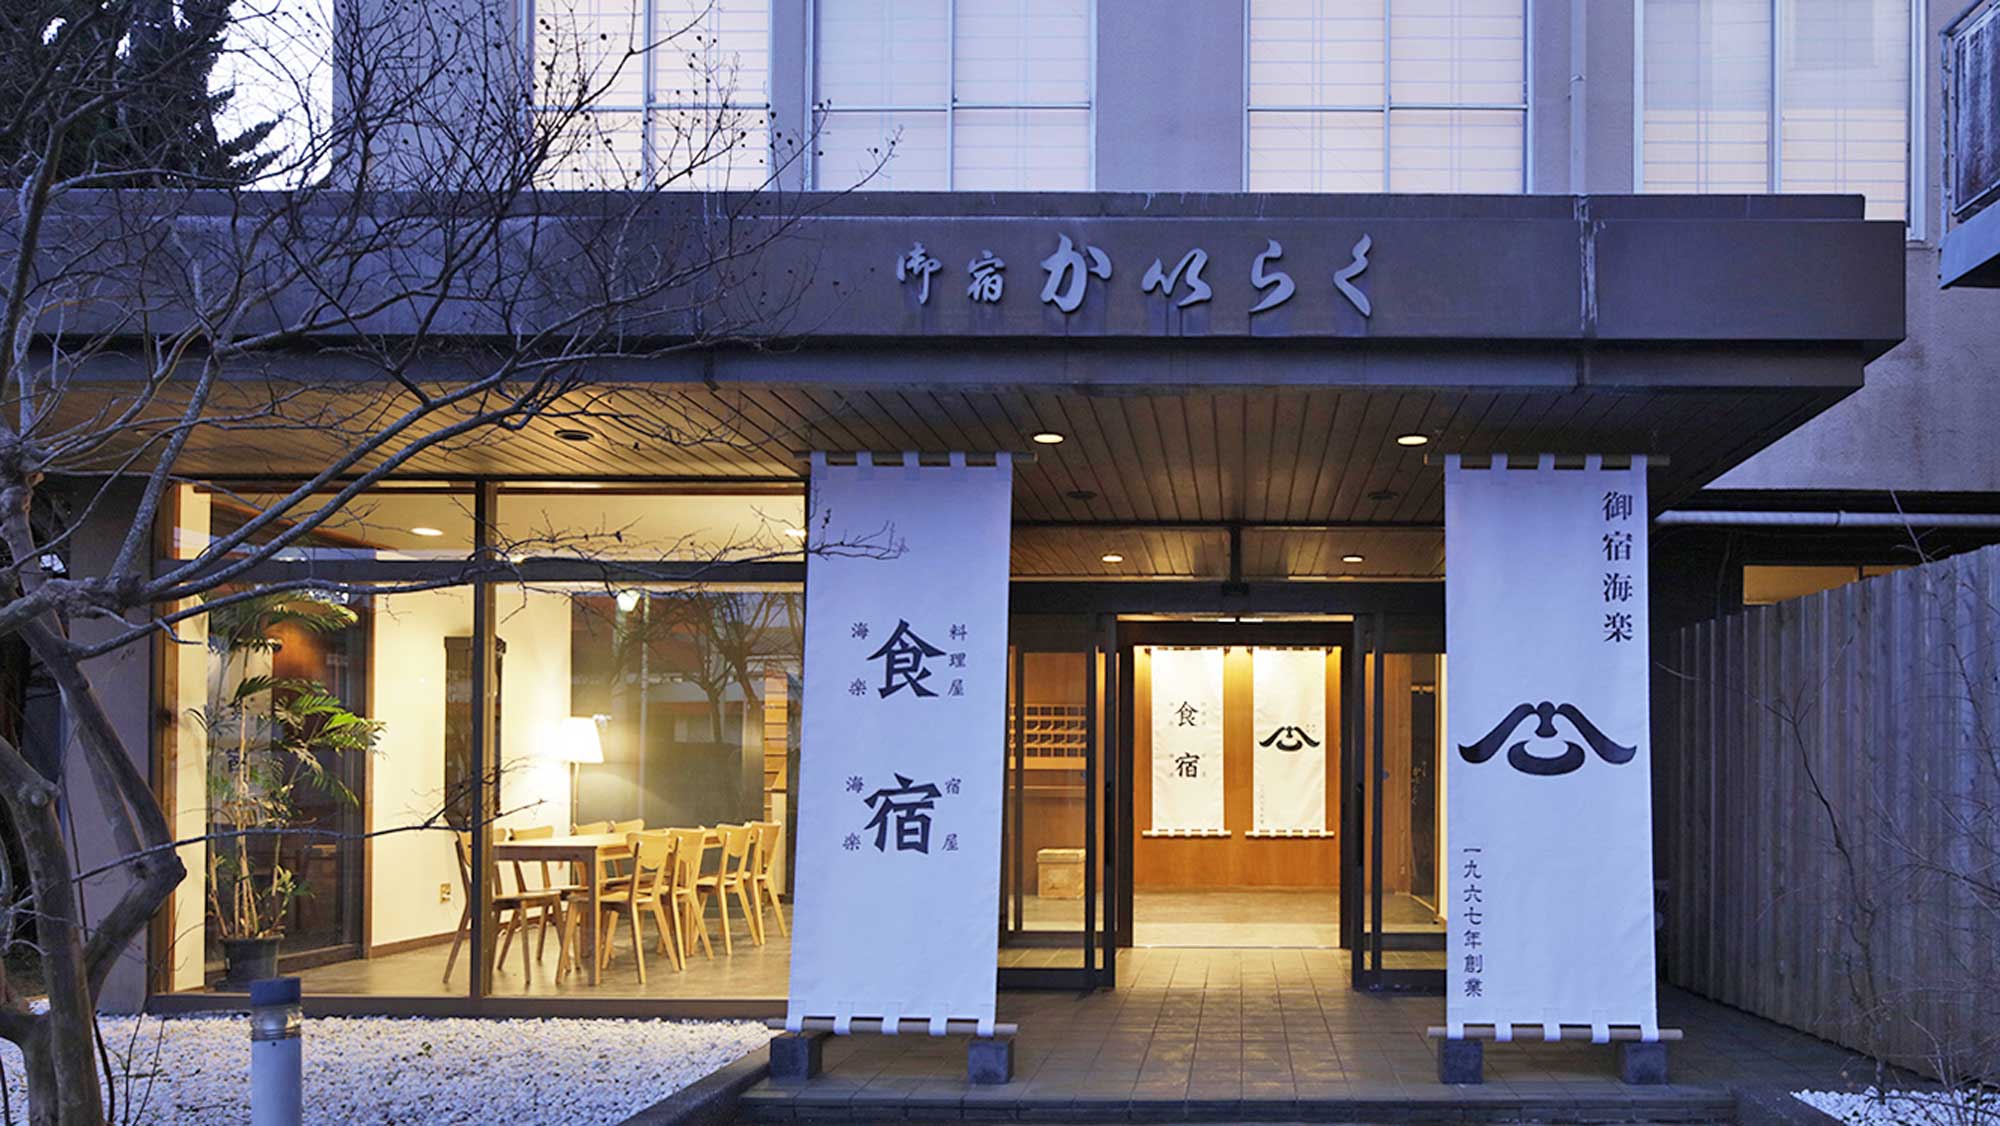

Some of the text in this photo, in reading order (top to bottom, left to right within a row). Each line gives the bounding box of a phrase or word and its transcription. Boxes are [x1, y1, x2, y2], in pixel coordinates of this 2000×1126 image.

[1602, 491, 1633, 643] 御宿海楽
[866, 618, 947, 699] 食
[1463, 848, 1484, 998] 一九六七年創業
